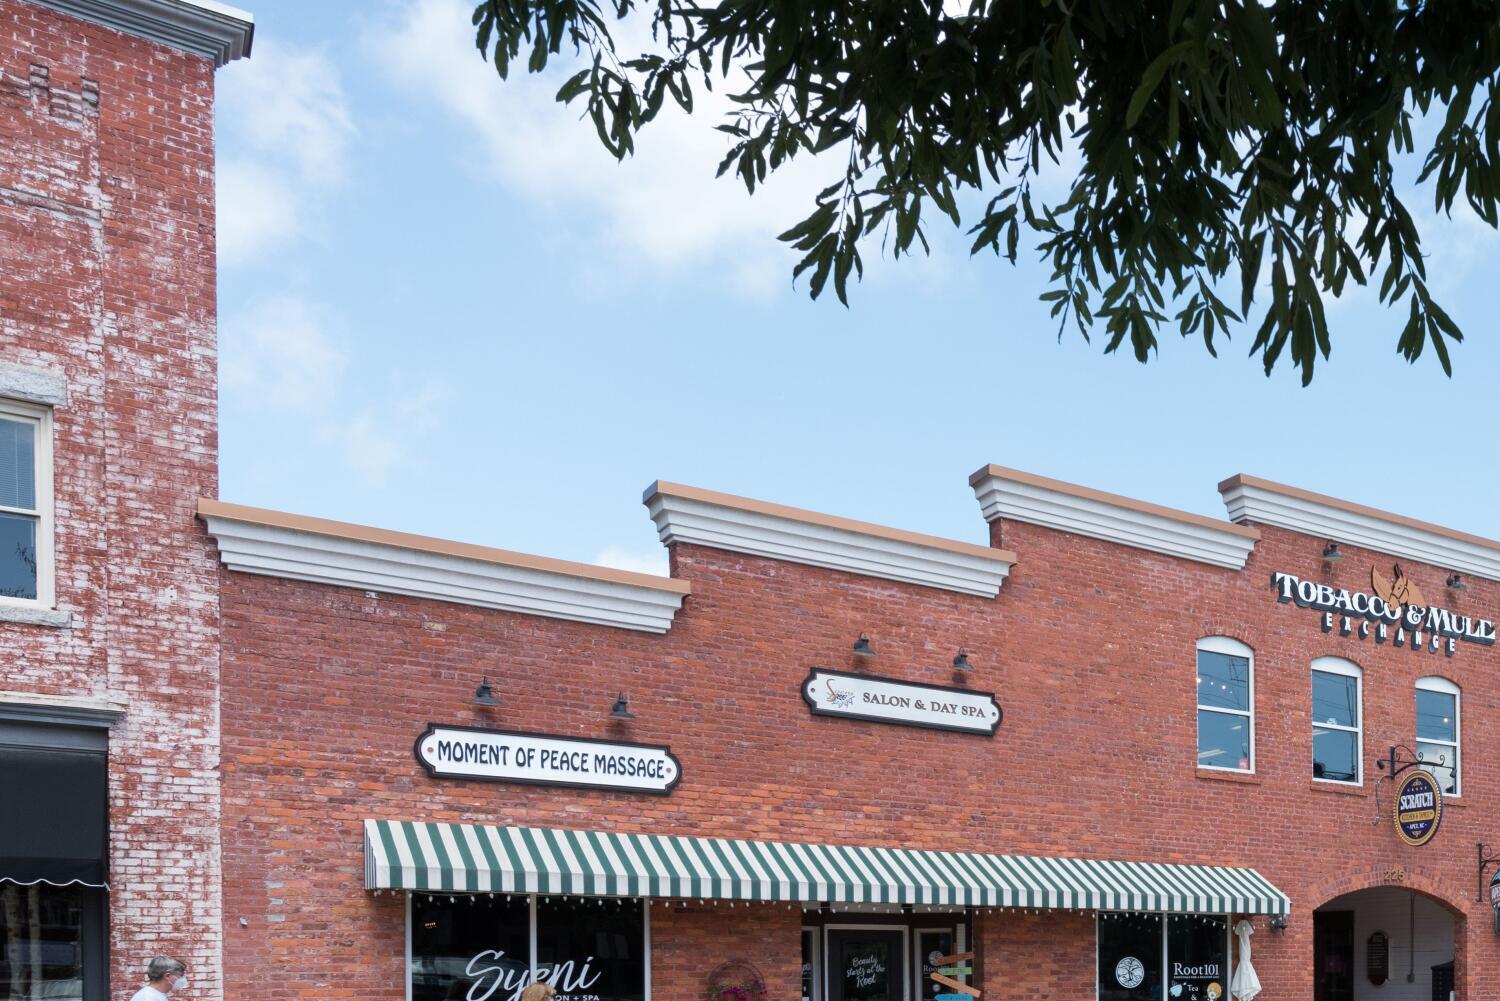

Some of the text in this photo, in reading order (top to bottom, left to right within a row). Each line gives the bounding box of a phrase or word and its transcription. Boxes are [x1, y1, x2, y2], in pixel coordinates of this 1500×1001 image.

[1275, 572, 1496, 640] TOBACCO & MULE
[1325, 612, 1456, 652] EXCHANGE
[863, 692, 910, 709] SALON
[914, 700, 926, 711] &
[931, 701, 958, 715] DAY
[961, 705, 987, 718] SPA
[438, 740, 665, 779] MOMENT OF PEACE MASSAGE
[1400, 792, 1434, 811] SCRATCH
[1384, 870, 1405, 881] 225
[852, 954, 878, 967] Beauty
[856, 973, 877, 989] Root
[1187, 984, 1199, 992] Tea
